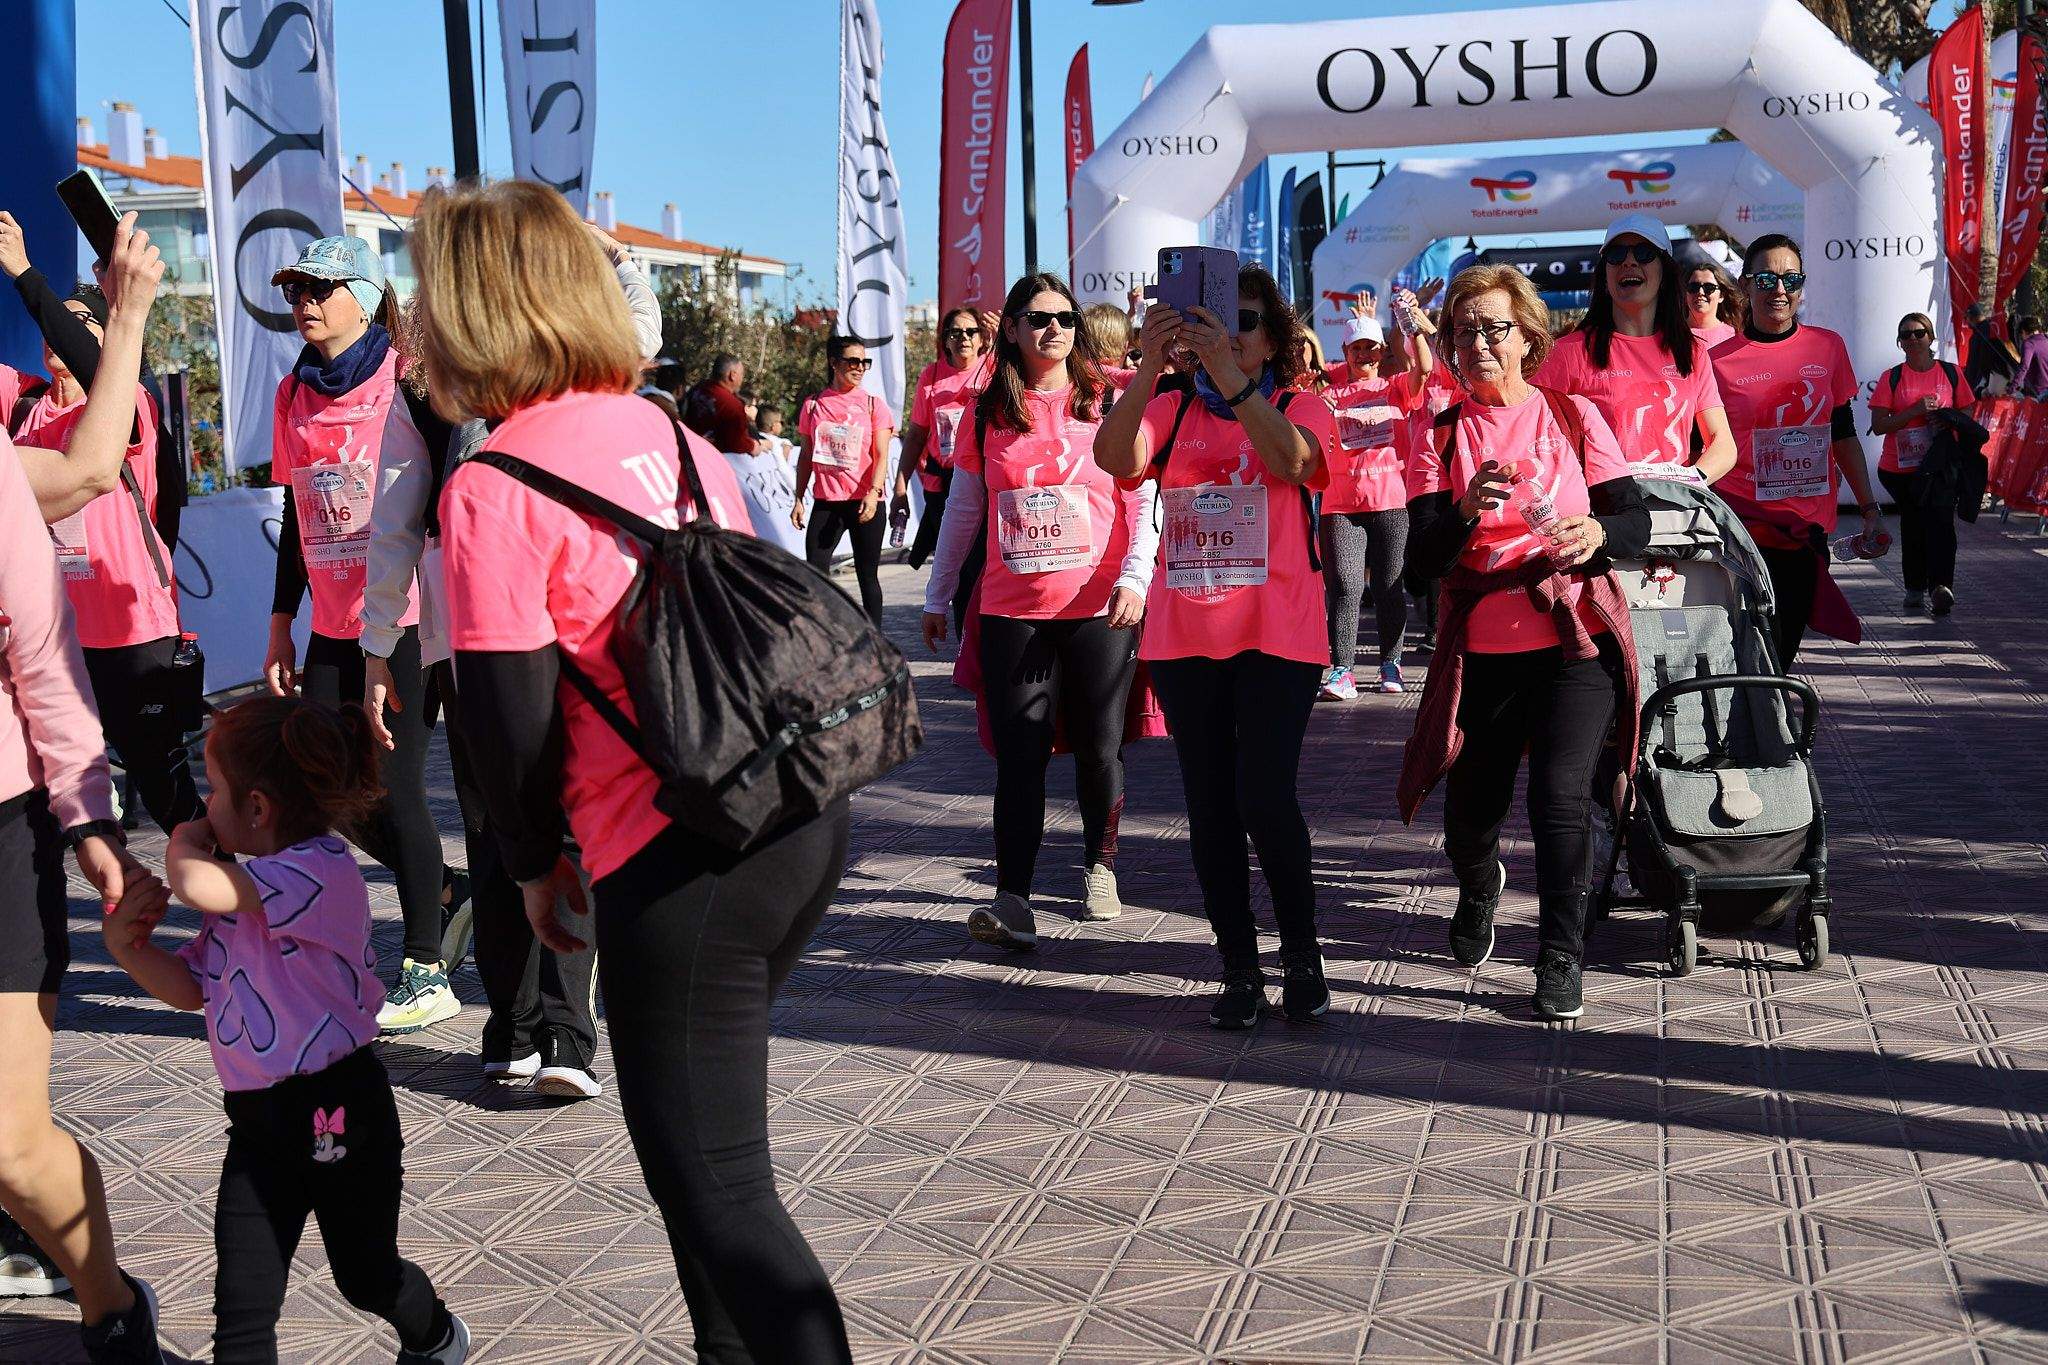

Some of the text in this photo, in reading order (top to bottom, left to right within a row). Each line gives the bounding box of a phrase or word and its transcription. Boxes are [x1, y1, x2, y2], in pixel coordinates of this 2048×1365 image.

[1316, 29, 1658, 114] OYSHO
[1763, 91, 1870, 119] OYSHO
[962, 30, 994, 216] Santander
[1952, 64, 1973, 215] Santander
[1123, 135, 1218, 157] OYSHO
[1608, 199, 1677, 211] TotalEnergies
[1471, 207, 1539, 219] TotalEnergies
[1824, 236, 1925, 261] OYSHO
[1596, 370, 1632, 379] OYSHO
[1736, 372, 1772, 386] OYSHO
[1783, 457, 1812, 471] 016
[1025, 499, 1058, 509] ASTURIANA
[1194, 501, 1231, 510] ASTURIANA
[319, 506, 352, 524] 016
[326, 526, 343, 535] 9264
[1027, 523, 1062, 540] 016
[1195, 530, 1234, 547] 016
[1035, 541, 1052, 549] 4760
[1010, 551, 1029, 559] CARRERA
[1202, 551, 1221, 559] 2852
[1011, 558, 1082, 570] OYSHO Santander
[1174, 561, 1194, 569] CARRERA
[1174, 572, 1203, 583] OYSHO
[1204, 586, 1218, 595] DE
